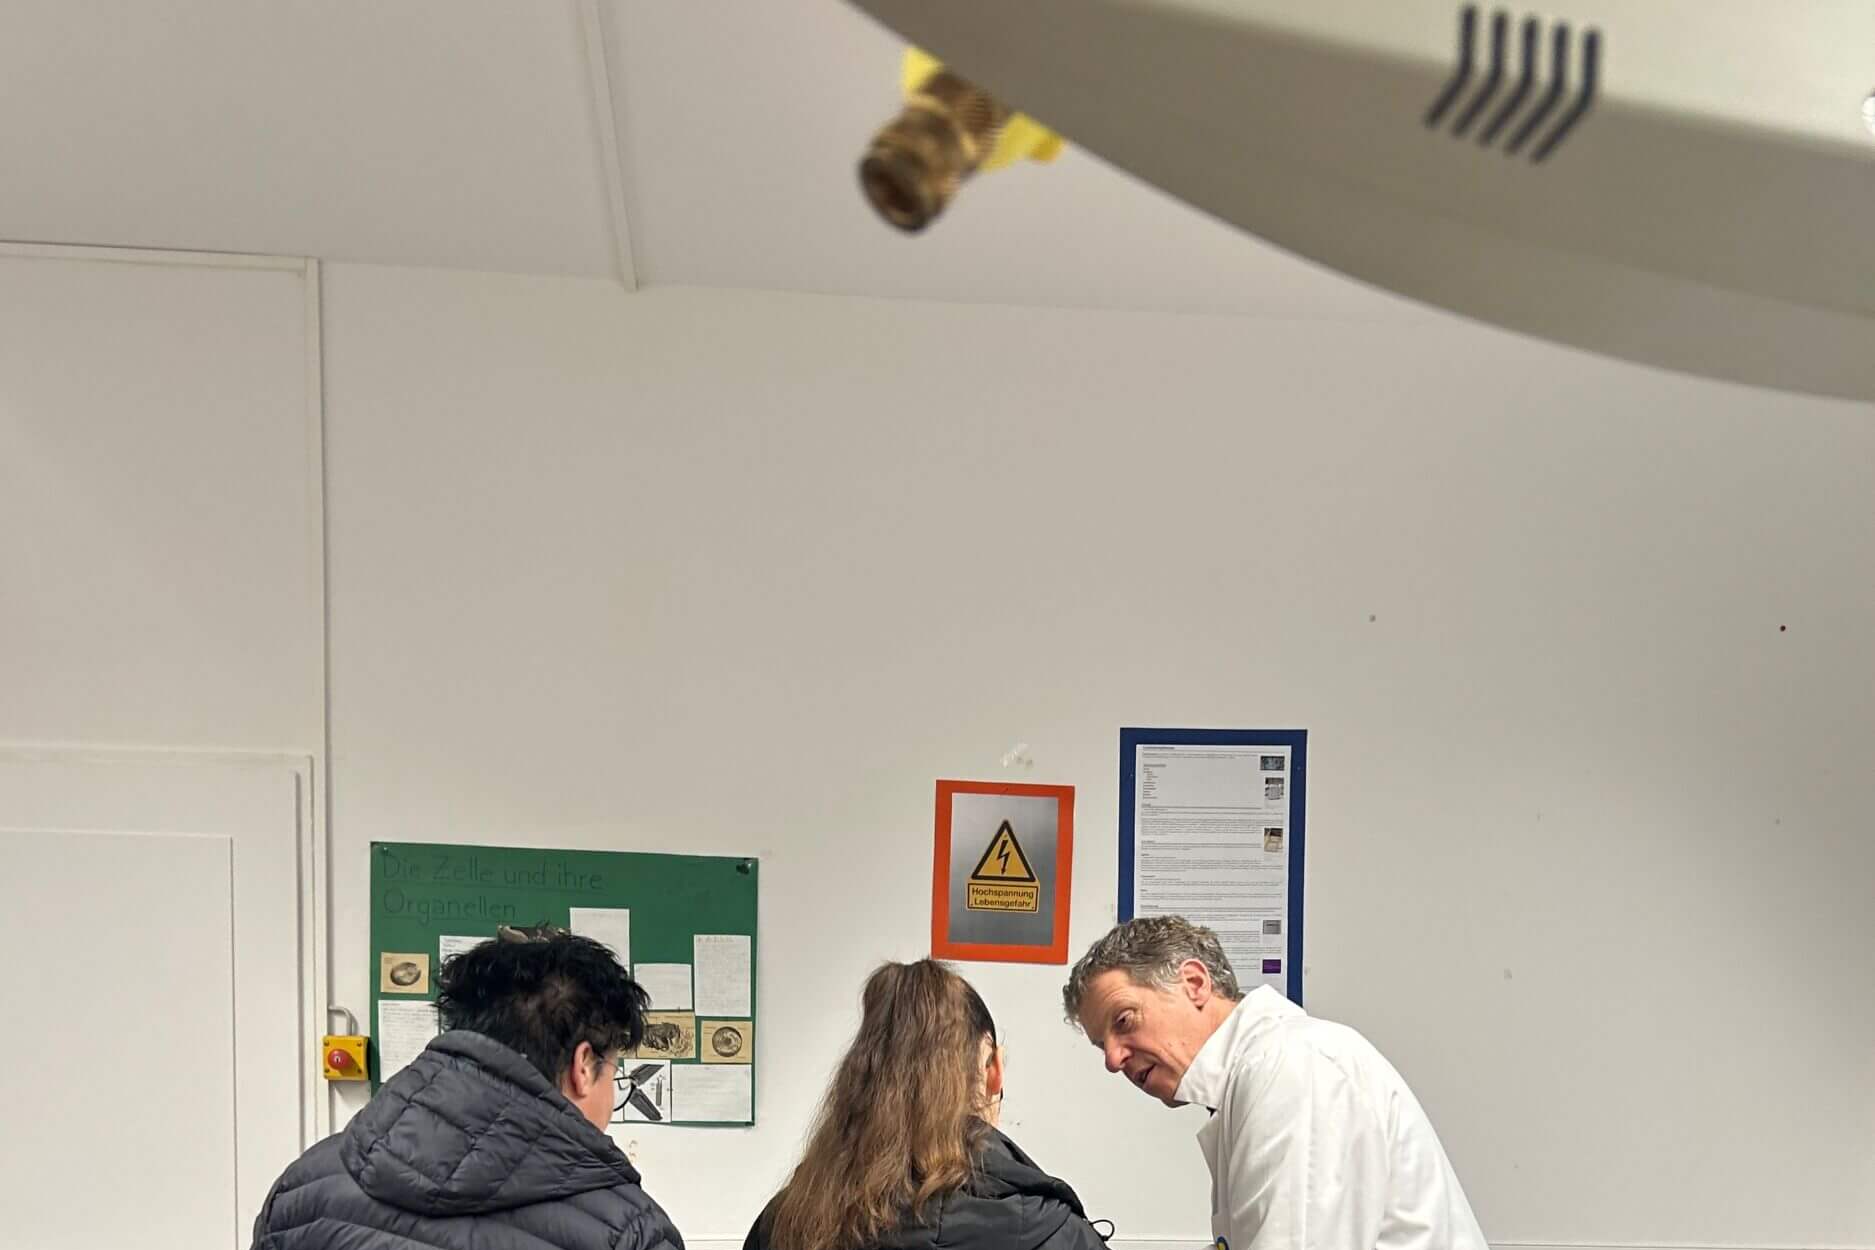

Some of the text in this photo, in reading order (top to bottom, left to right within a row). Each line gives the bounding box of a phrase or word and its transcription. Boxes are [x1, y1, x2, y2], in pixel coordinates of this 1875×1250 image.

[383, 854, 604, 890] Die Zelle und ihre
[971, 887, 1034, 899] Hochspannung
[974, 898, 1031, 908] Lebensgefahr
[383, 888, 516, 925] Organellen
